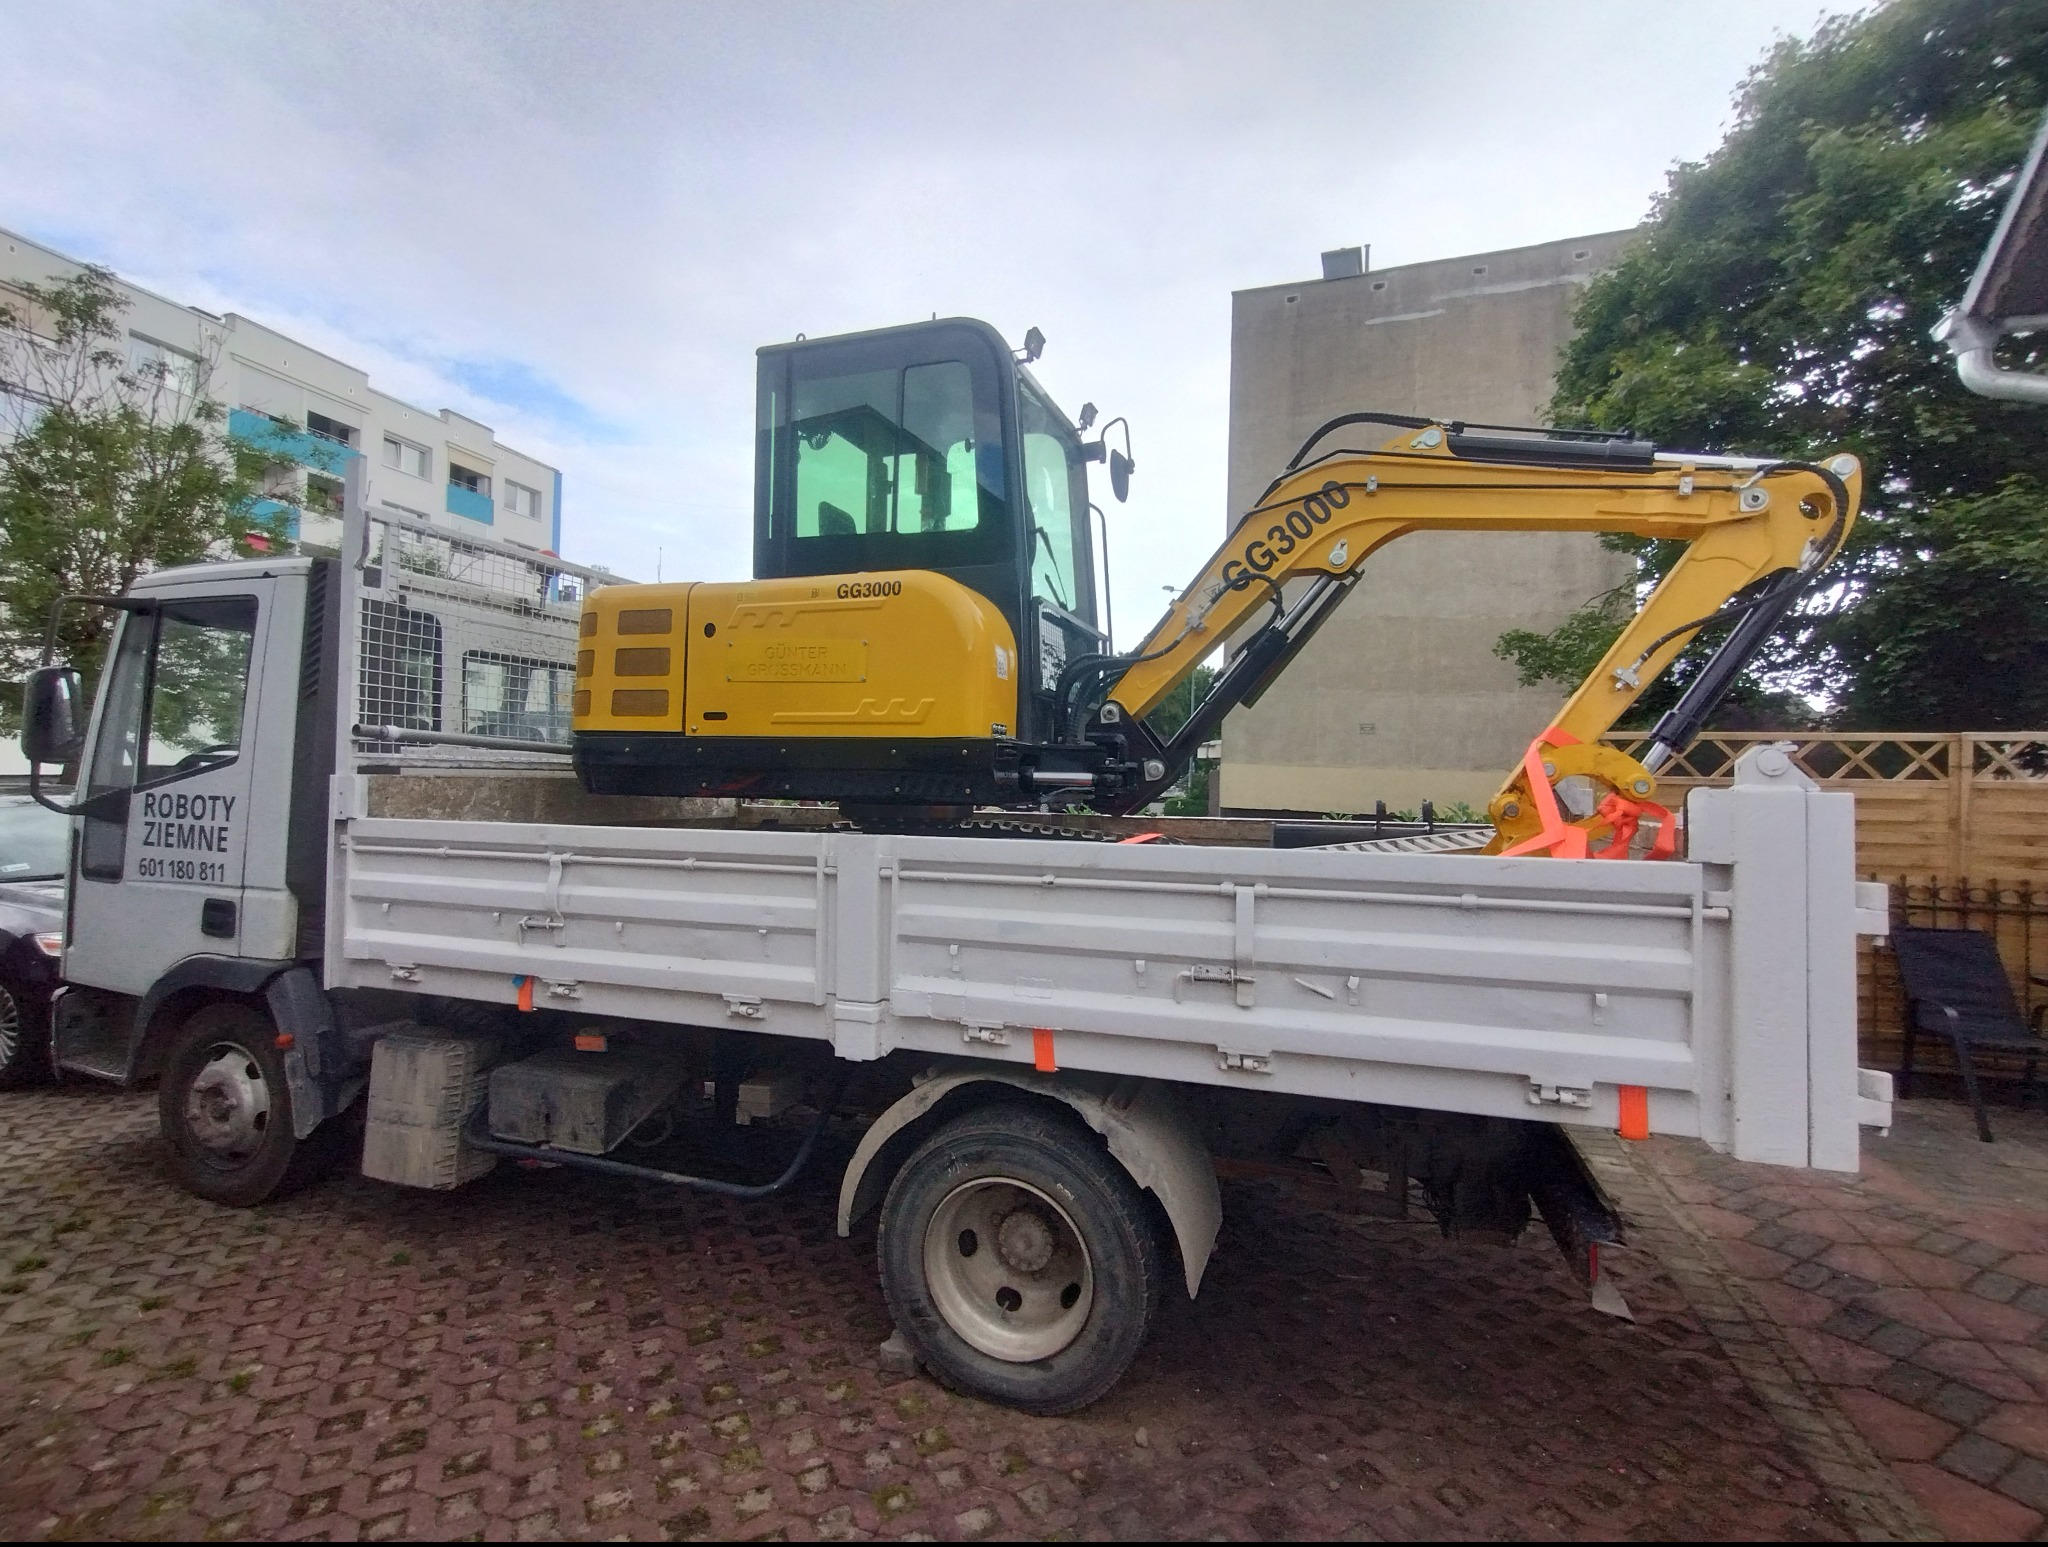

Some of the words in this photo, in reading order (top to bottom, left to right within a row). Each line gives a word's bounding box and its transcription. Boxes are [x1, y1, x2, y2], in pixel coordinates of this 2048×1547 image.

[1222, 480, 1350, 591] GG3000
[837, 581, 902, 599] GG3000
[764, 642, 828, 660] GÜNTER
[144, 792, 236, 822] ROBOTY
[143, 821, 229, 853] ZIEMNE
[139, 858, 165, 878] 601
[168, 860, 195, 880] 180
[199, 862, 225, 882] 811
